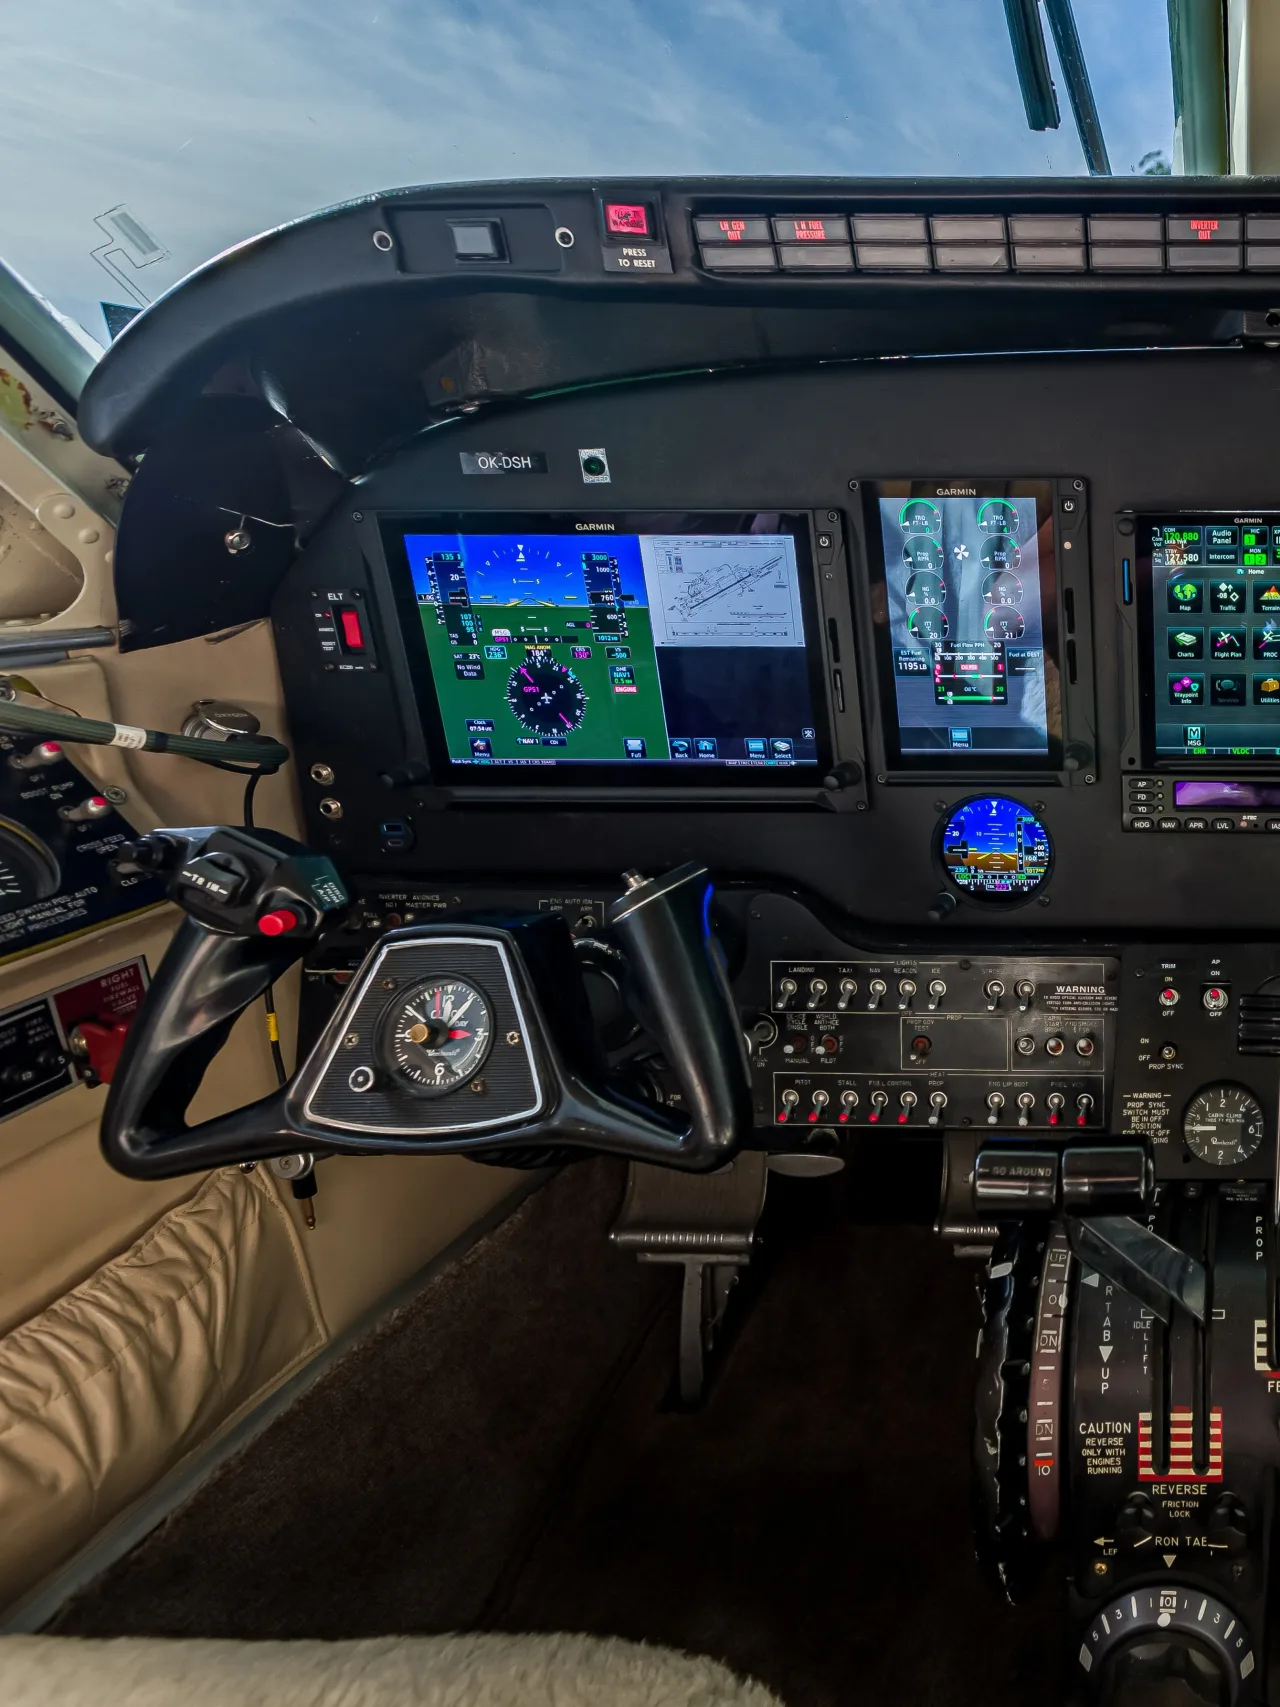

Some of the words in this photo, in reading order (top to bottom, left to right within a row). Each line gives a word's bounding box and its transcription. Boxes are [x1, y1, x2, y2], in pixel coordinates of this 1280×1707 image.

[719, 221, 730, 230] LH
[731, 221, 745, 230] GEN
[809, 221, 823, 230] FUEL
[1190, 220, 1218, 230] INVERTER
[728, 231, 741, 240] OUT
[796, 230, 826, 239] PRESSURE
[1198, 231, 1211, 240] OUT
[623, 248, 646, 257] PRESS
[618, 259, 630, 267] TO
[633, 259, 656, 268] RESET
[478, 456, 532, 469] OK-DSH
[936, 488, 976, 496] GARMIN
[1165, 533, 1199, 541] 120.880
[1165, 553, 1199, 562] 127.580
[327, 593, 343, 601] ELT
[898, 662, 918, 670] 1195
[100, 968, 135, 988] RIGHT
[992, 1168, 1007, 1176] GO
[1009, 1168, 1051, 1177] AROUND
[1133, 1321, 1151, 1329] IDLE
[1079, 1422, 1132, 1435] CAUTION
[1086, 1438, 1123, 1446] REVERSE
[1081, 1448, 1103, 1456] ONLY
[1087, 1458, 1121, 1466] ENGINES
[1087, 1466, 1122, 1474] RUNNING
[1152, 1485, 1207, 1495] REVERSE
